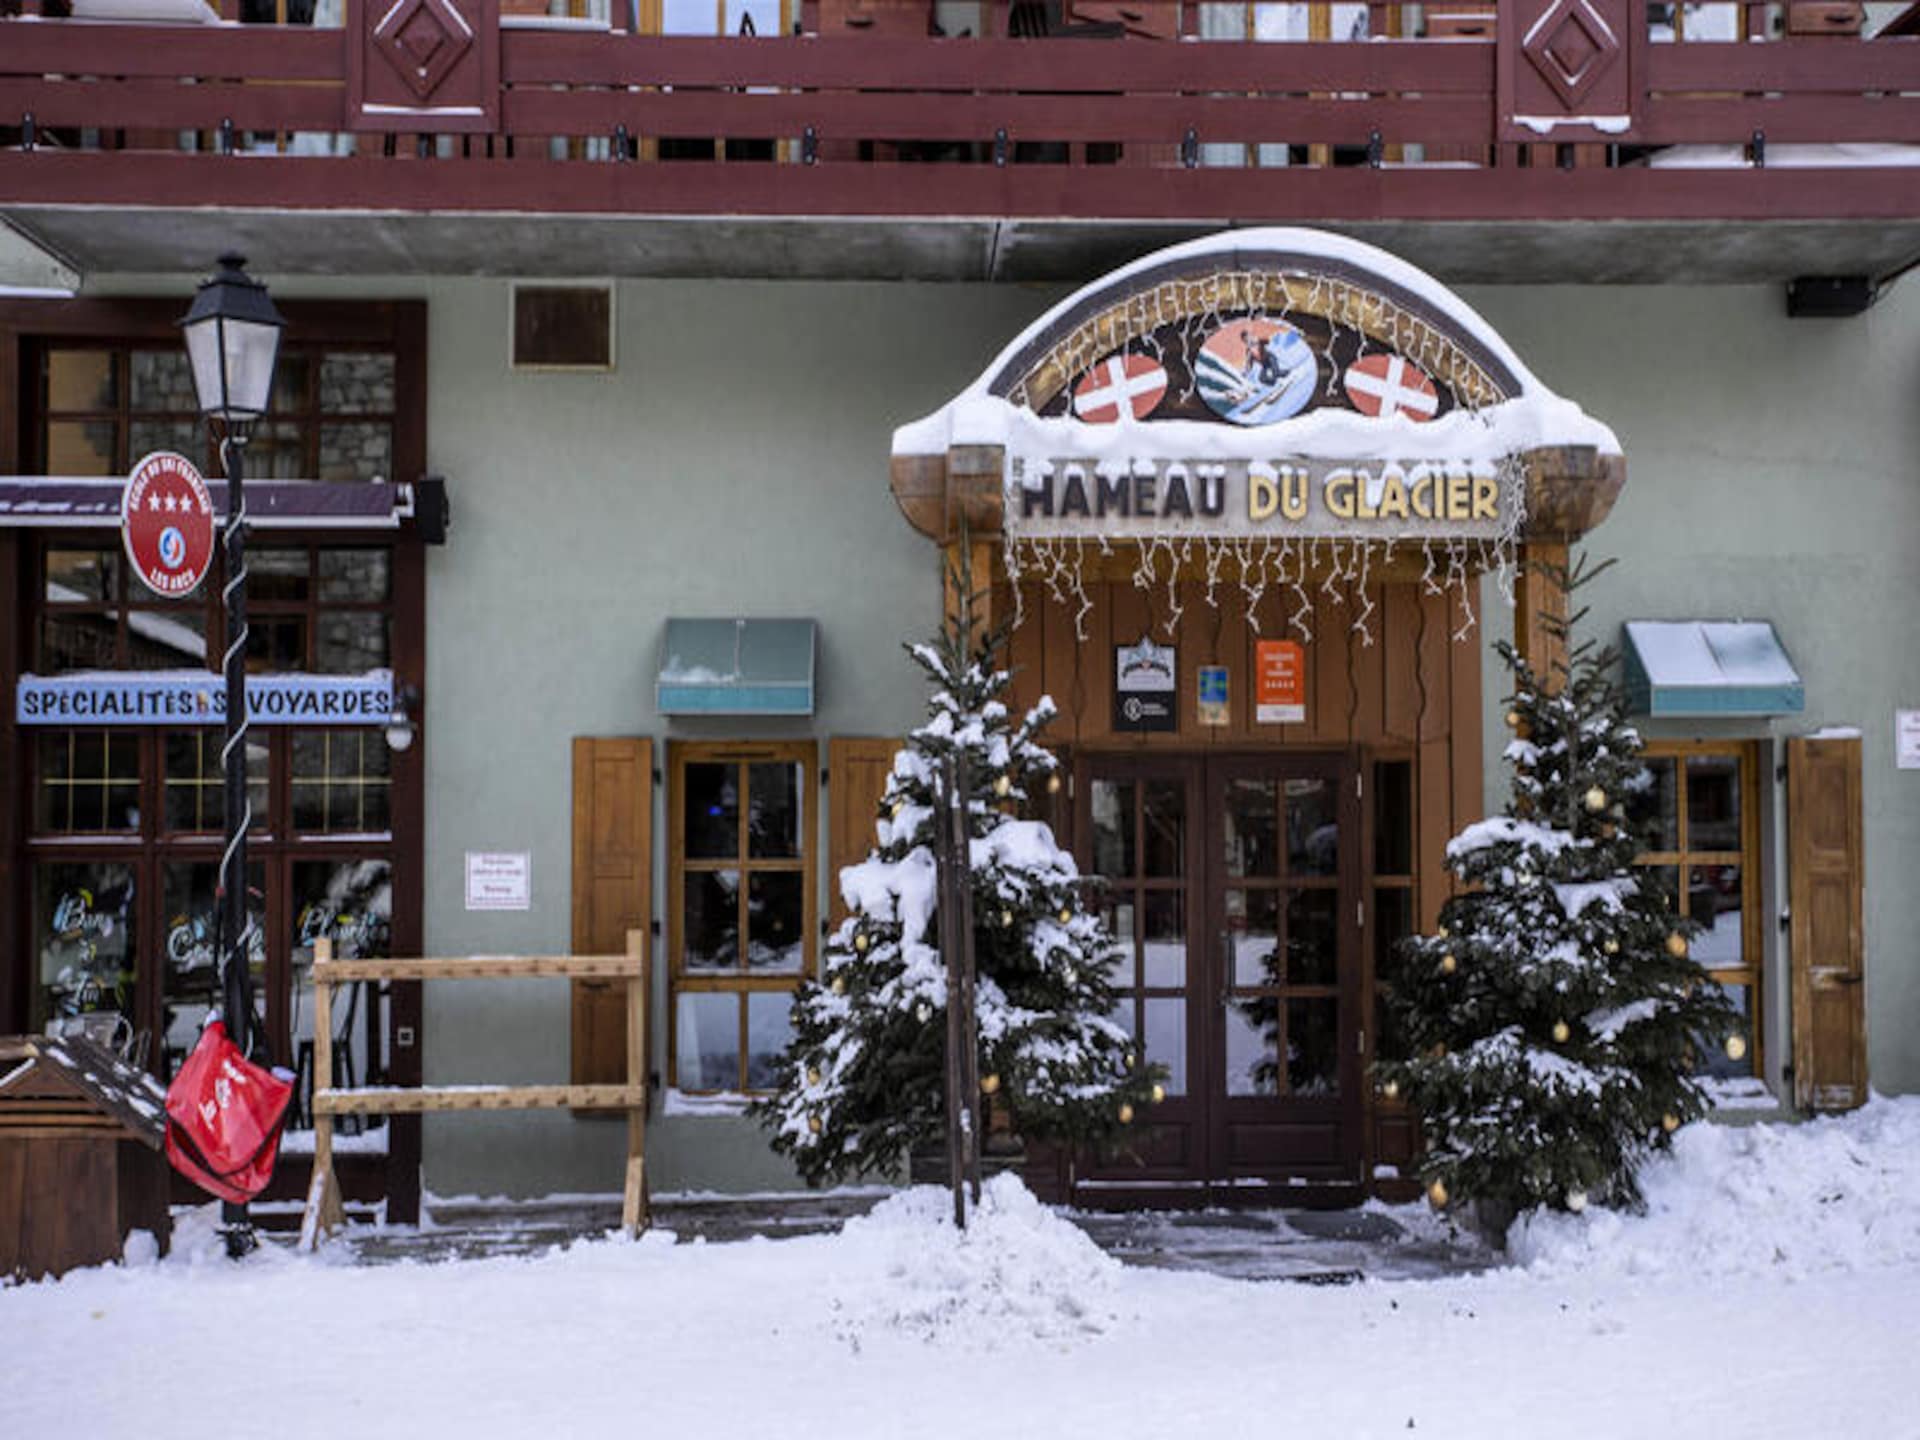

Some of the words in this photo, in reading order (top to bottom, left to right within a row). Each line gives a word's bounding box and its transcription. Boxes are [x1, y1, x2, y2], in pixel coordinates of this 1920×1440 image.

[1021, 470, 1225, 518] HAMEAU
[1248, 470, 1309, 521] DU
[1323, 471, 1499, 520] GLACIER
[213, 689, 390, 715] SVOYARDES
